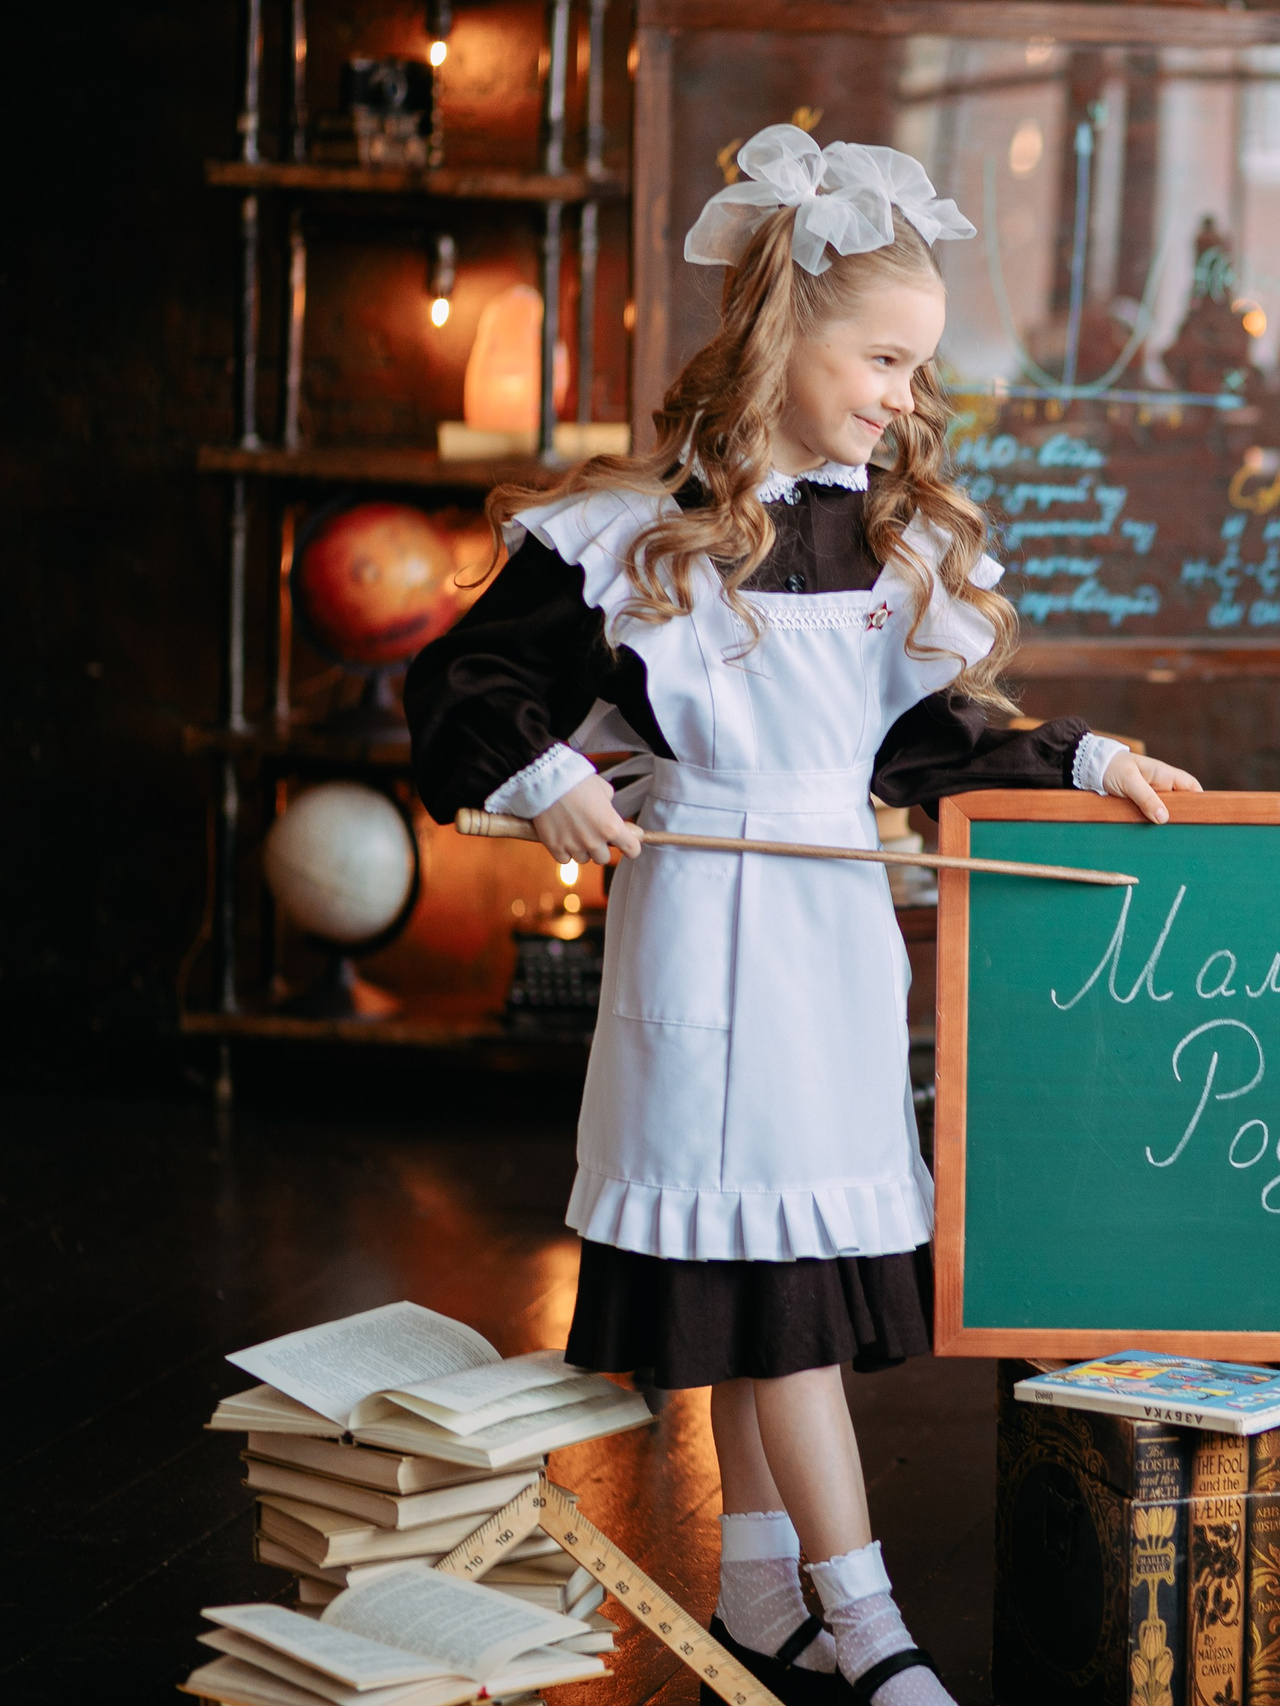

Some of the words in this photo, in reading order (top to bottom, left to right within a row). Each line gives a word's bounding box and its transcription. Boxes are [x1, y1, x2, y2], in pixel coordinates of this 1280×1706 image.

[1143, 1405, 1204, 1424] АЗБУКА
[1197, 1455, 1216, 1478] THE
[1199, 1477, 1220, 1491] and
[1223, 1477, 1240, 1490] the
[532, 1497, 547, 1508] 90
[495, 1528, 514, 1547] 100
[563, 1531, 579, 1547] 80
[464, 1555, 484, 1573] 110
[591, 1558, 606, 1572] 70
[615, 1580, 630, 1595] 60
[637, 1601, 652, 1615] 50
[658, 1621, 672, 1635] 40
[679, 1641, 694, 1656] 30
[704, 1664, 719, 1679] 20
[1202, 1662, 1236, 1677] CAWEIN
